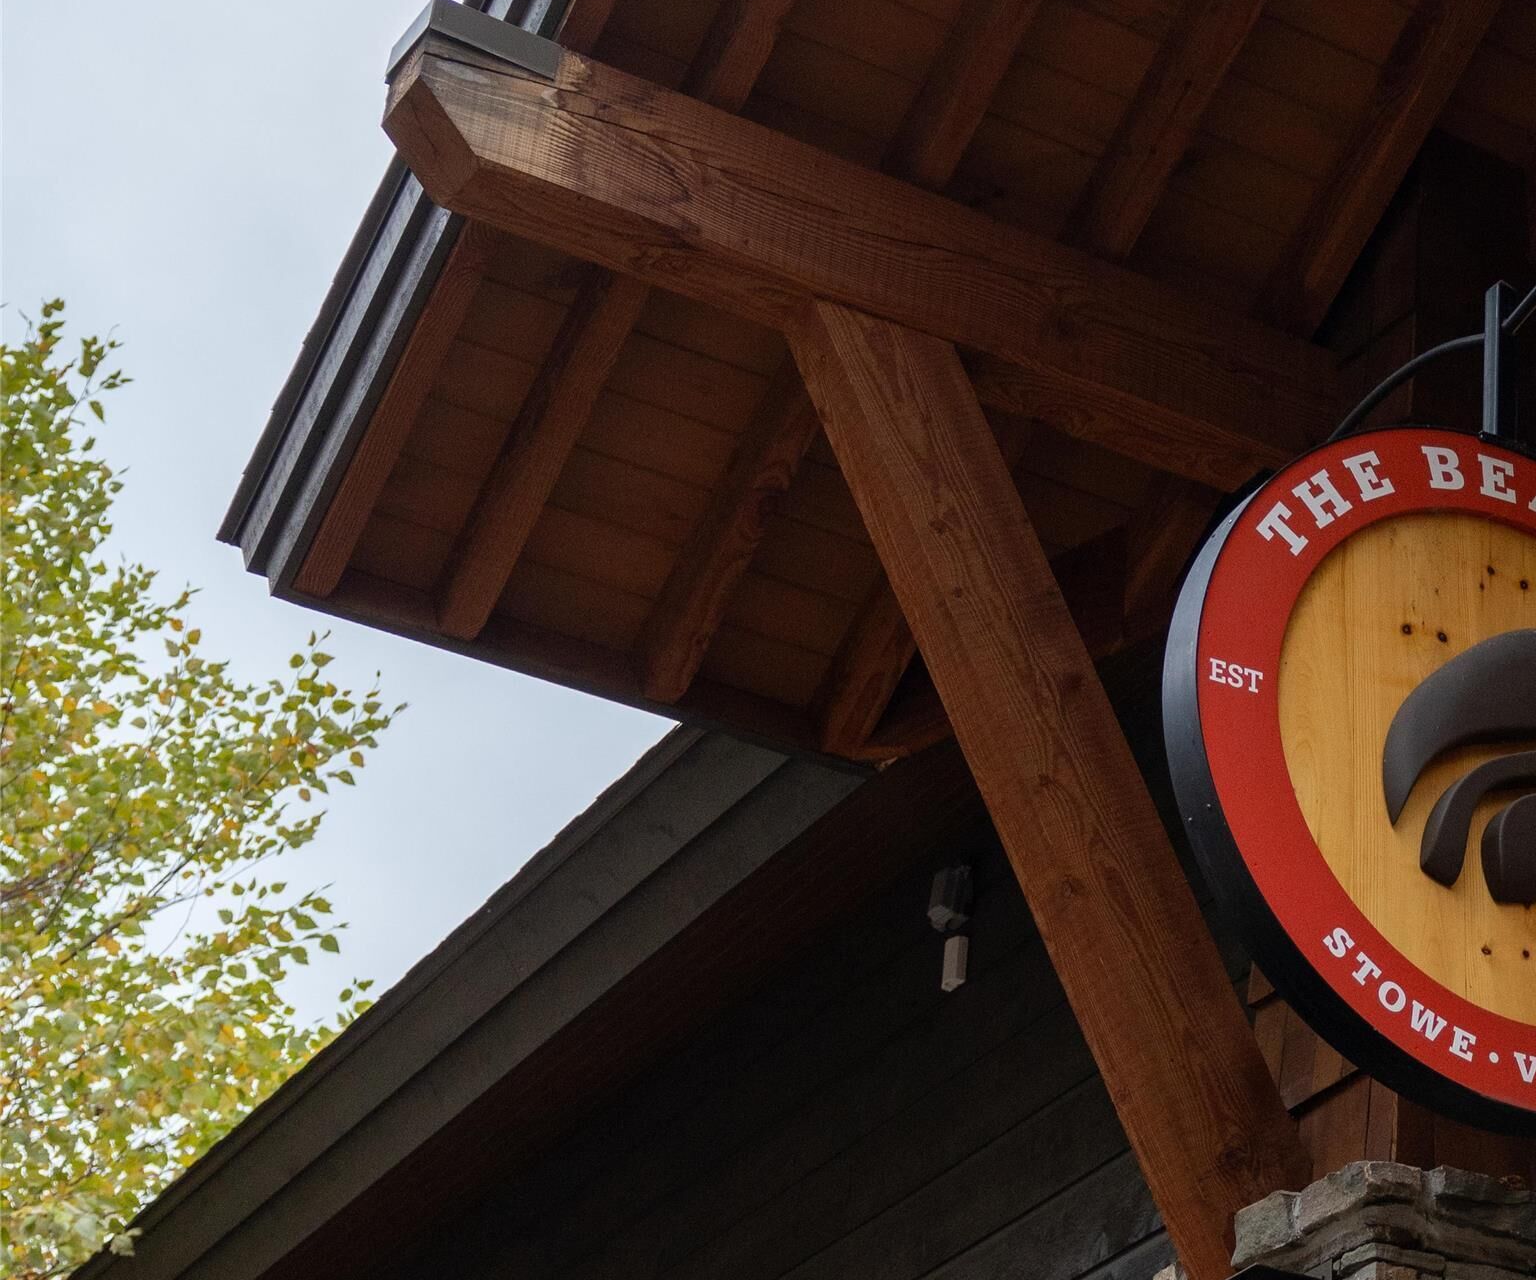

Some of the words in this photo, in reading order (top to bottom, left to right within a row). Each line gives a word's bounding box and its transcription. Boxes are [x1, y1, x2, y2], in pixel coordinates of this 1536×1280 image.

[1256, 450, 1395, 556] THE
[1208, 657, 1264, 695] EST
[1322, 927, 1477, 1063] STOWE
